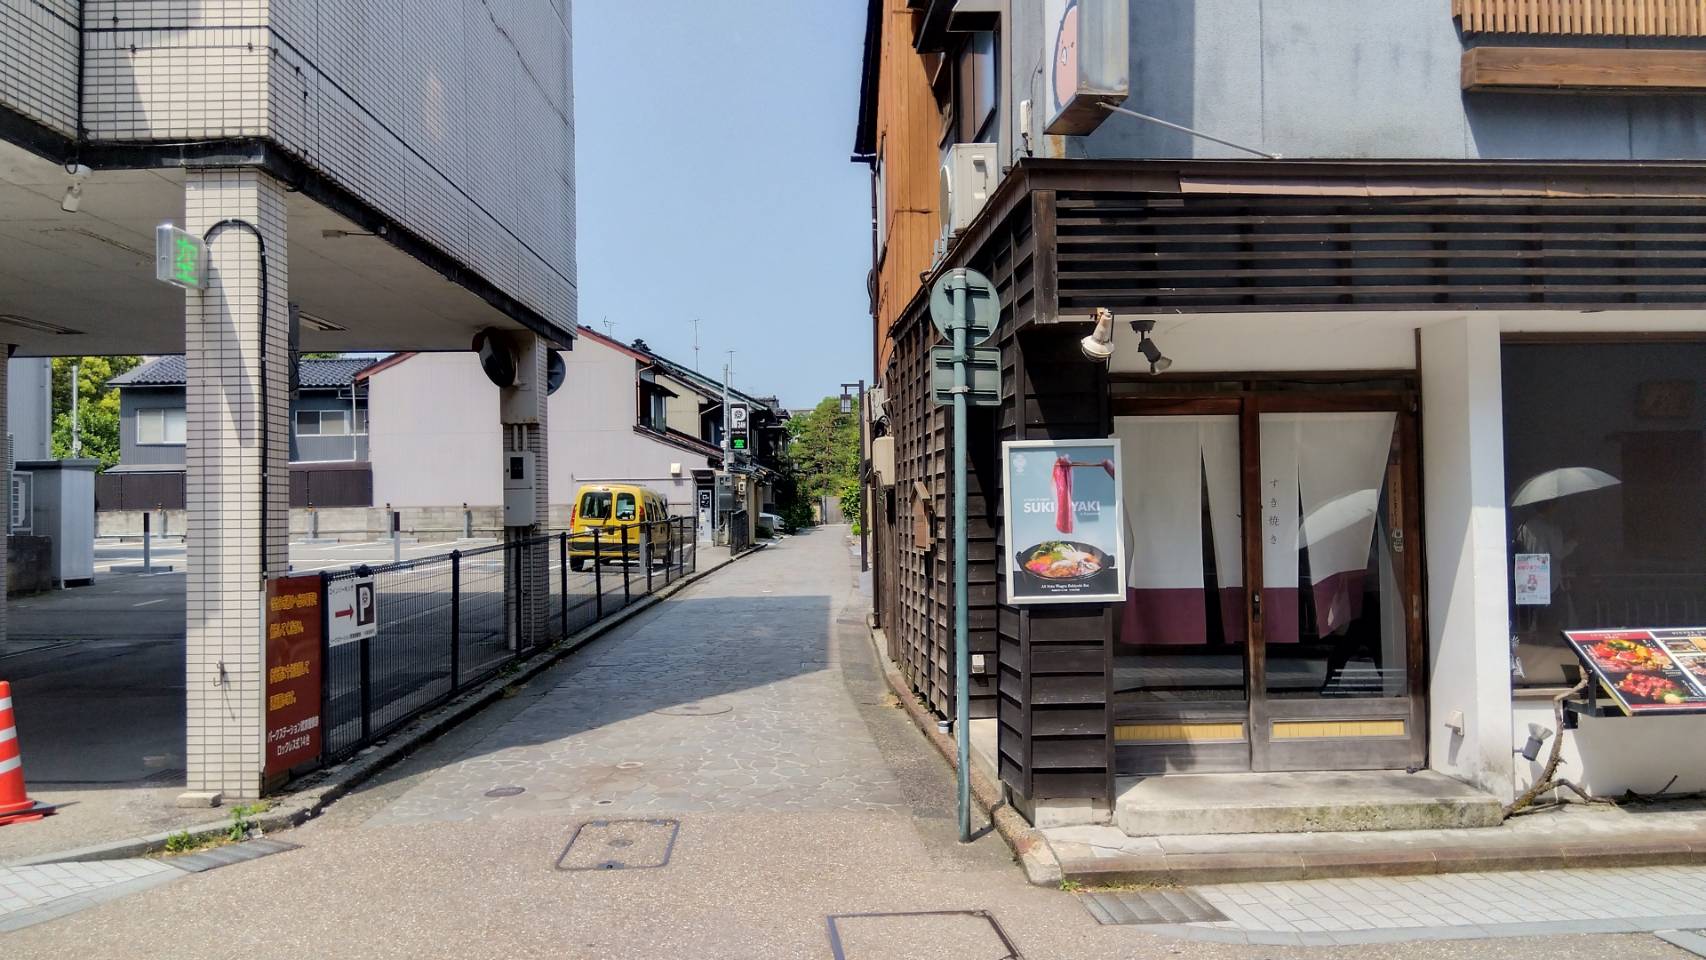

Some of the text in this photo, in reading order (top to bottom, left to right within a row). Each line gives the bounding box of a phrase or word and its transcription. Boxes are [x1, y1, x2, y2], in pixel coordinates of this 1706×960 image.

[731, 407, 746, 428] P
[1023, 501, 1101, 513] SUKI YAKI
[359, 586, 371, 622] P
